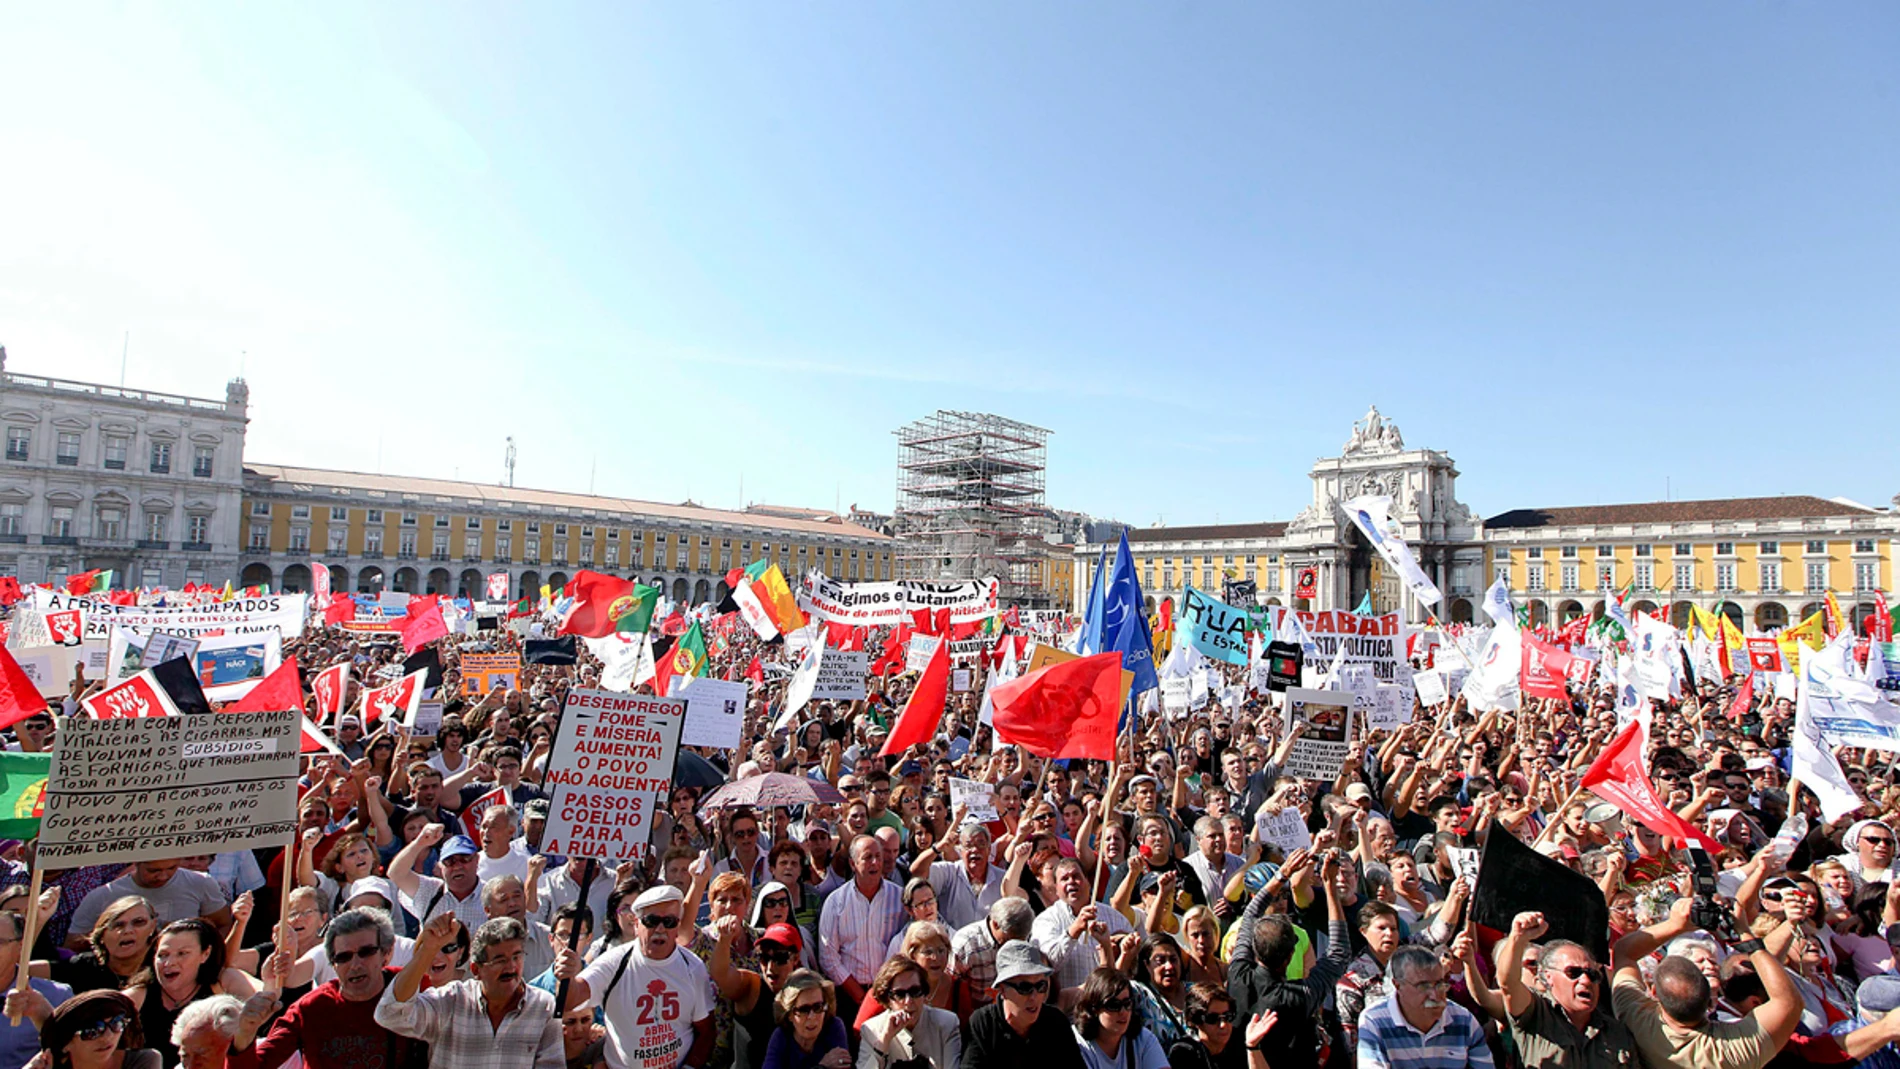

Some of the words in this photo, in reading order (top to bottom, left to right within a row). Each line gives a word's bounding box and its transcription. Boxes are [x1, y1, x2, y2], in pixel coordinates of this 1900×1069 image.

[48, 595, 61, 609] A
[819, 583, 891, 608] Exigimos
[894, 591, 904, 602] e
[811, 596, 850, 618] Mudar
[853, 606, 869, 618] de
[950, 602, 988, 617] olítica!
[1183, 590, 1248, 644] RUA
[567, 694, 683, 716] DESEMPREGO
[65, 718, 137, 731] ACABEM
[144, 716, 181, 730] COM
[188, 715, 209, 727] AS
[213, 710, 296, 725] REFORMAS
[598, 711, 647, 728] FOME
[262, 725, 292, 737] MAS
[575, 724, 588, 738] E
[157, 745, 177, 757] OS
[209, 750, 297, 767] TRABALHARAM
[573, 740, 663, 761] AUMENTA!
[577, 756, 591, 770] O
[596, 758, 648, 775] POVO
[54, 775, 98, 790] TODA
[106, 775, 118, 787] A
[545, 768, 584, 786] NÃO
[50, 796, 62, 810] O
[69, 793, 117, 810] POVO
[123, 791, 149, 810] JÁ
[235, 782, 266, 794] MAS
[268, 780, 287, 792] OS
[564, 792, 642, 811] PASSOS
[46, 809, 167, 829] GOVERNANTES
[175, 802, 224, 818] AGORA
[229, 794, 259, 811] NÃO
[561, 807, 642, 827] COELHO
[139, 836, 150, 849] E
[153, 835, 173, 848] OS
[570, 824, 624, 842] PARA
[546, 838, 560, 854] A
[567, 840, 608, 858] RUA
[615, 841, 647, 859] JÁ!
[636, 991, 680, 1026] 25
[639, 1031, 677, 1048] SEMPRE
[644, 1023, 674, 1037] ABRIL
[634, 1037, 683, 1060] FASCISMO
[643, 1050, 679, 1068] NUNCA
